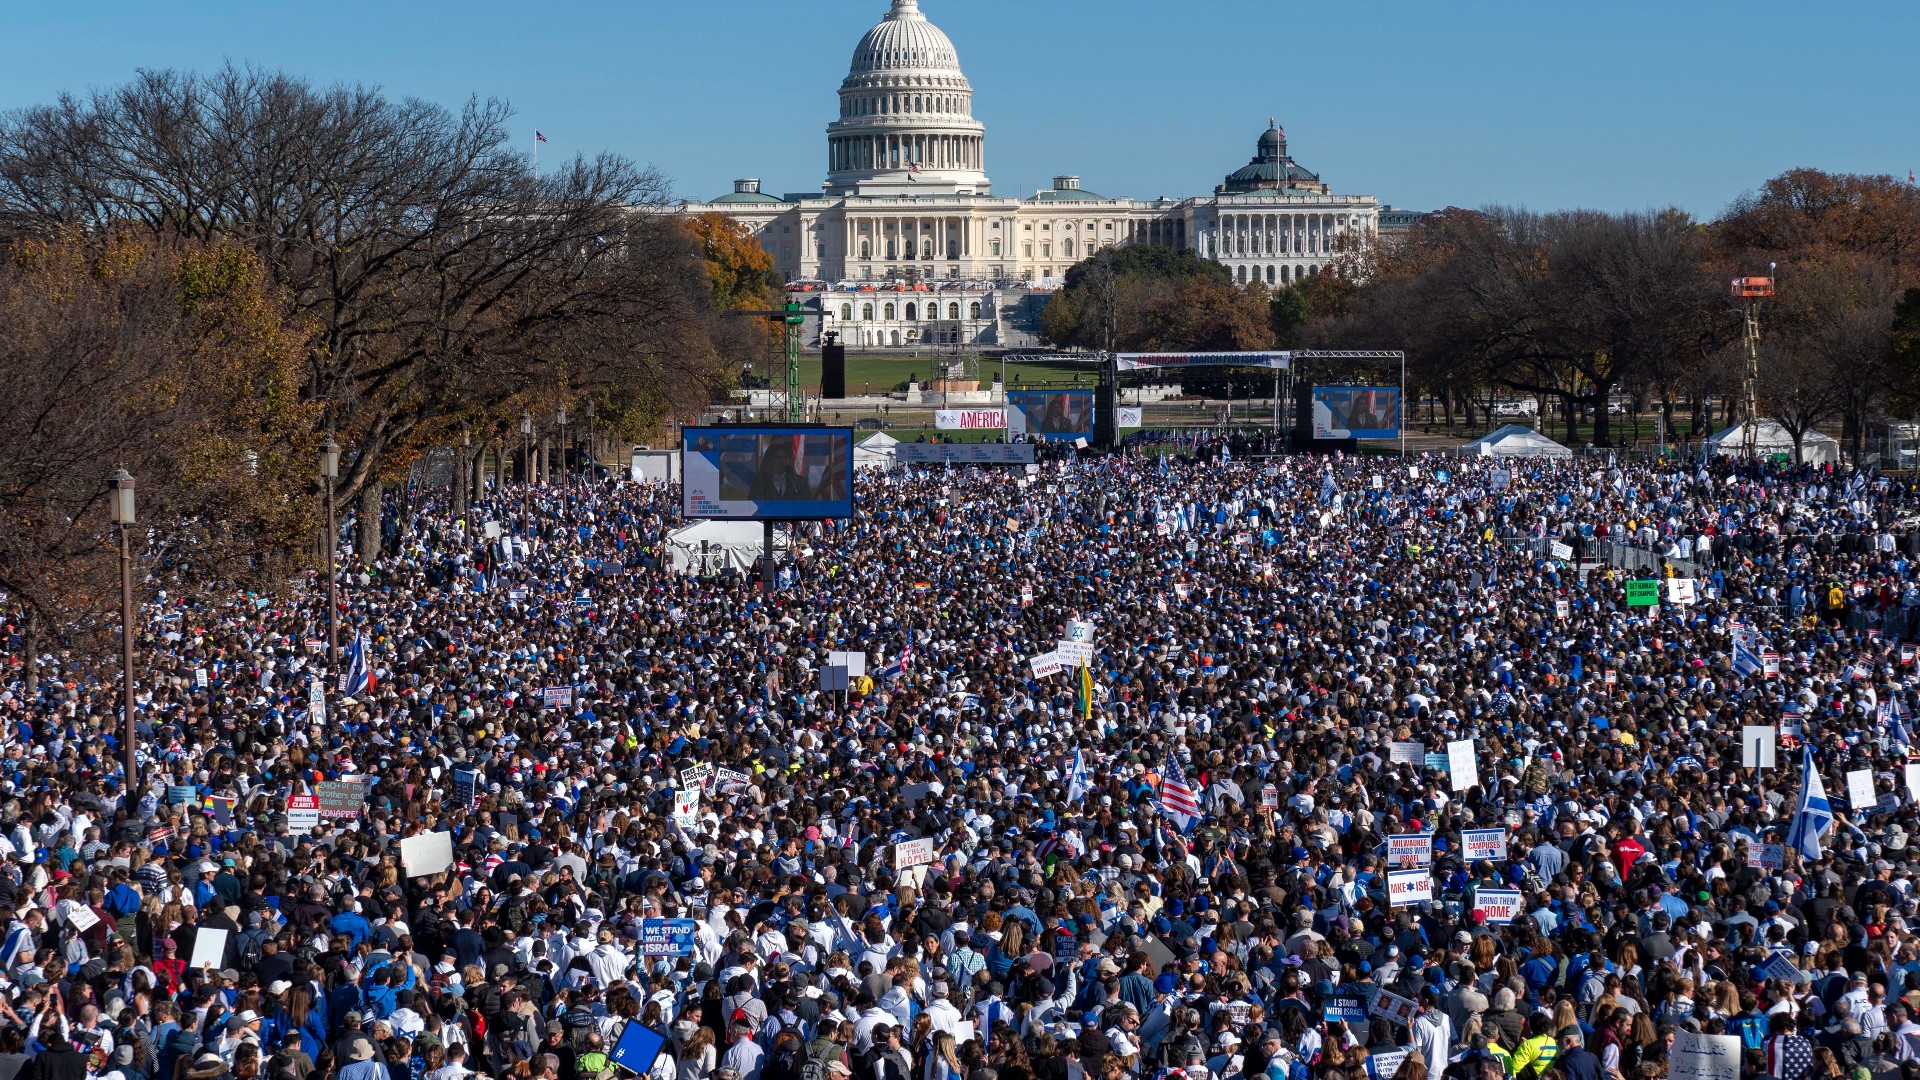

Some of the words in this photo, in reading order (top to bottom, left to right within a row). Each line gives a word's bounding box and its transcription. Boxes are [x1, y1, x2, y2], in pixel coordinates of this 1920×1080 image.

[1137, 355, 1188, 366] AMERICANS
[1190, 355, 1221, 364] MARCH
[1224, 355, 1240, 364] FOR
[1242, 354, 1270, 364] ISRAEL
[960, 412, 1008, 428] AMERICA
[1036, 662, 1060, 675] HAMAS
[682, 768, 695, 777] FREE
[697, 764, 707, 772] THE
[352, 782, 364, 791] my
[318, 790, 348, 799] brothers
[351, 791, 364, 800] and
[319, 798, 342, 806] sisters
[320, 809, 362, 818] KIDNAPPED
[899, 842, 920, 852] BRING
[1392, 839, 1427, 847] MILWAUKEE
[1468, 841, 1501, 849] CAMPUSES
[906, 846, 926, 856] THEM
[1390, 847, 1413, 855] STANDS
[1414, 846, 1430, 854] WITH
[900, 853, 930, 867] HOME
[1390, 883, 1406, 894] MKE
[1415, 880, 1430, 891] ISR
[1479, 896, 1498, 904] BRING
[1499, 896, 1517, 905] THEM
[1484, 906, 1510, 917] HOME
[661, 926, 690, 934] STAND
[645, 943, 681, 952] ISRAEL
[1772, 965, 1783, 976] WITH
[1774, 962, 1791, 978] STANDS
[1778, 958, 1795, 975] DALLAS
[1334, 998, 1337, 1006] I
[1338, 999, 1358, 1007] STAND
[1326, 1007, 1342, 1015] WITH
[1344, 1008, 1363, 1016] ISRAEL
[616, 1048, 626, 1059] #
